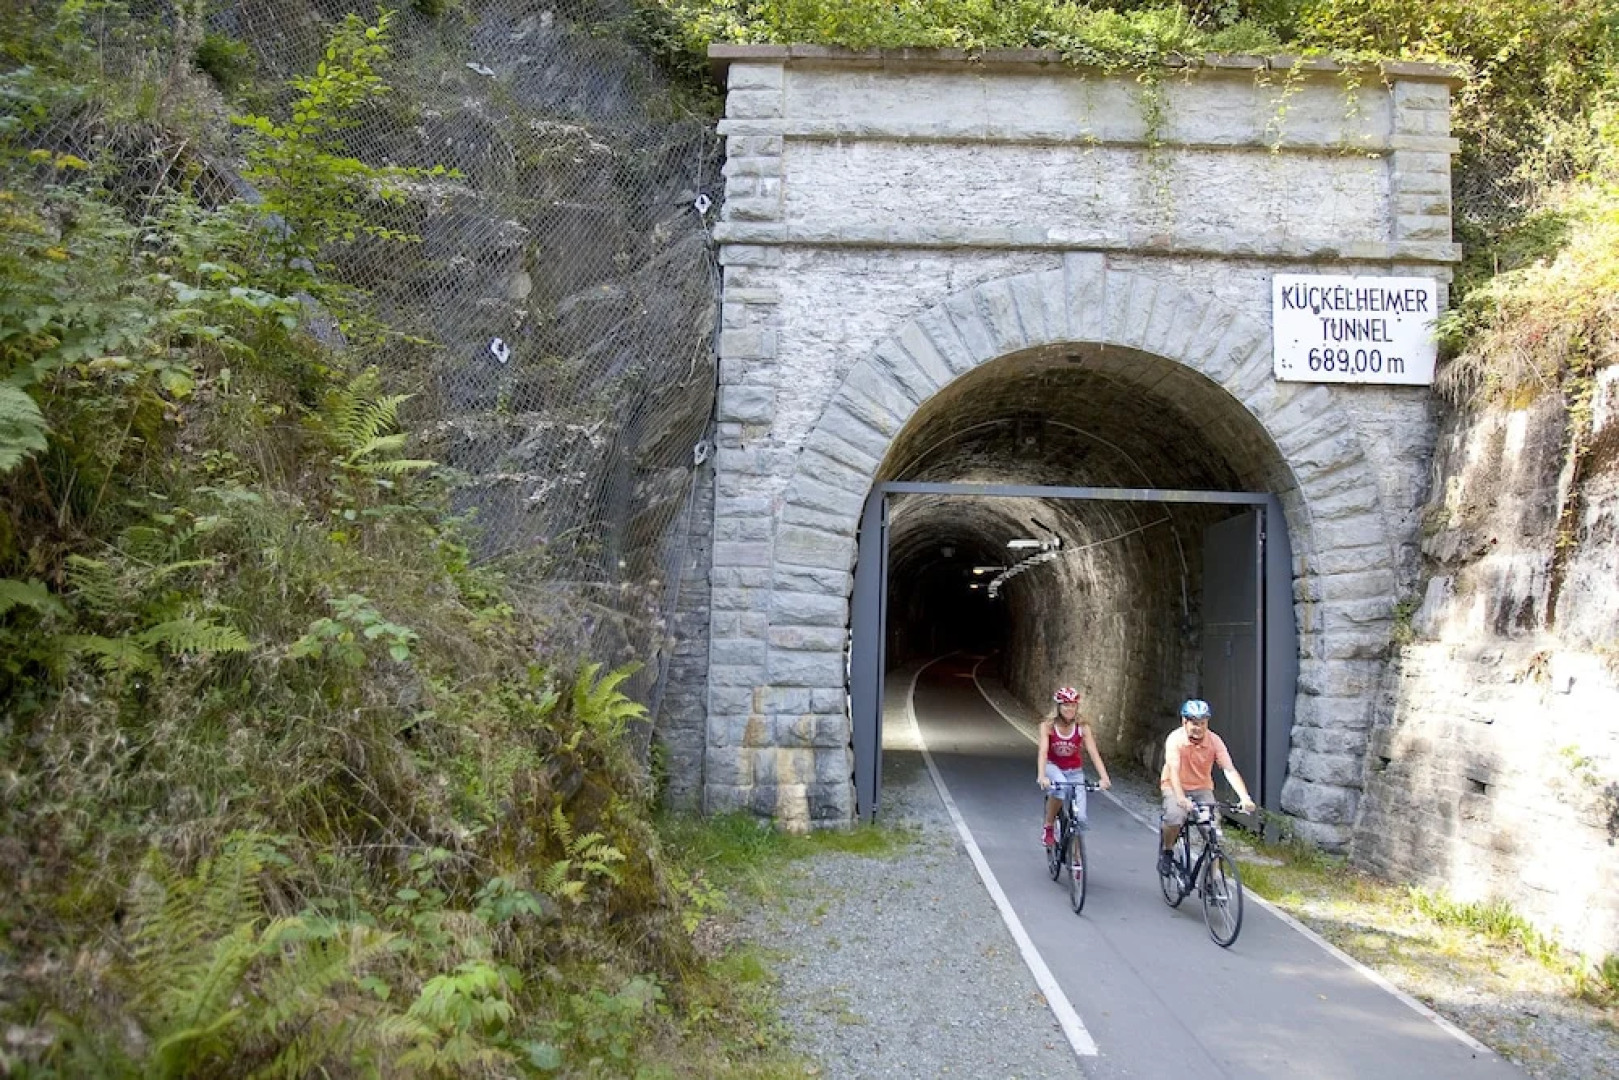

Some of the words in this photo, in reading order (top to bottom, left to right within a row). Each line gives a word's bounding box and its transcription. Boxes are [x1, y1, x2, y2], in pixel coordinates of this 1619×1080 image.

[1282, 283, 1428, 312] KÜCKELHEIMER
[1319, 317, 1393, 342] TUNNEL
[1387, 356, 1405, 374] m
